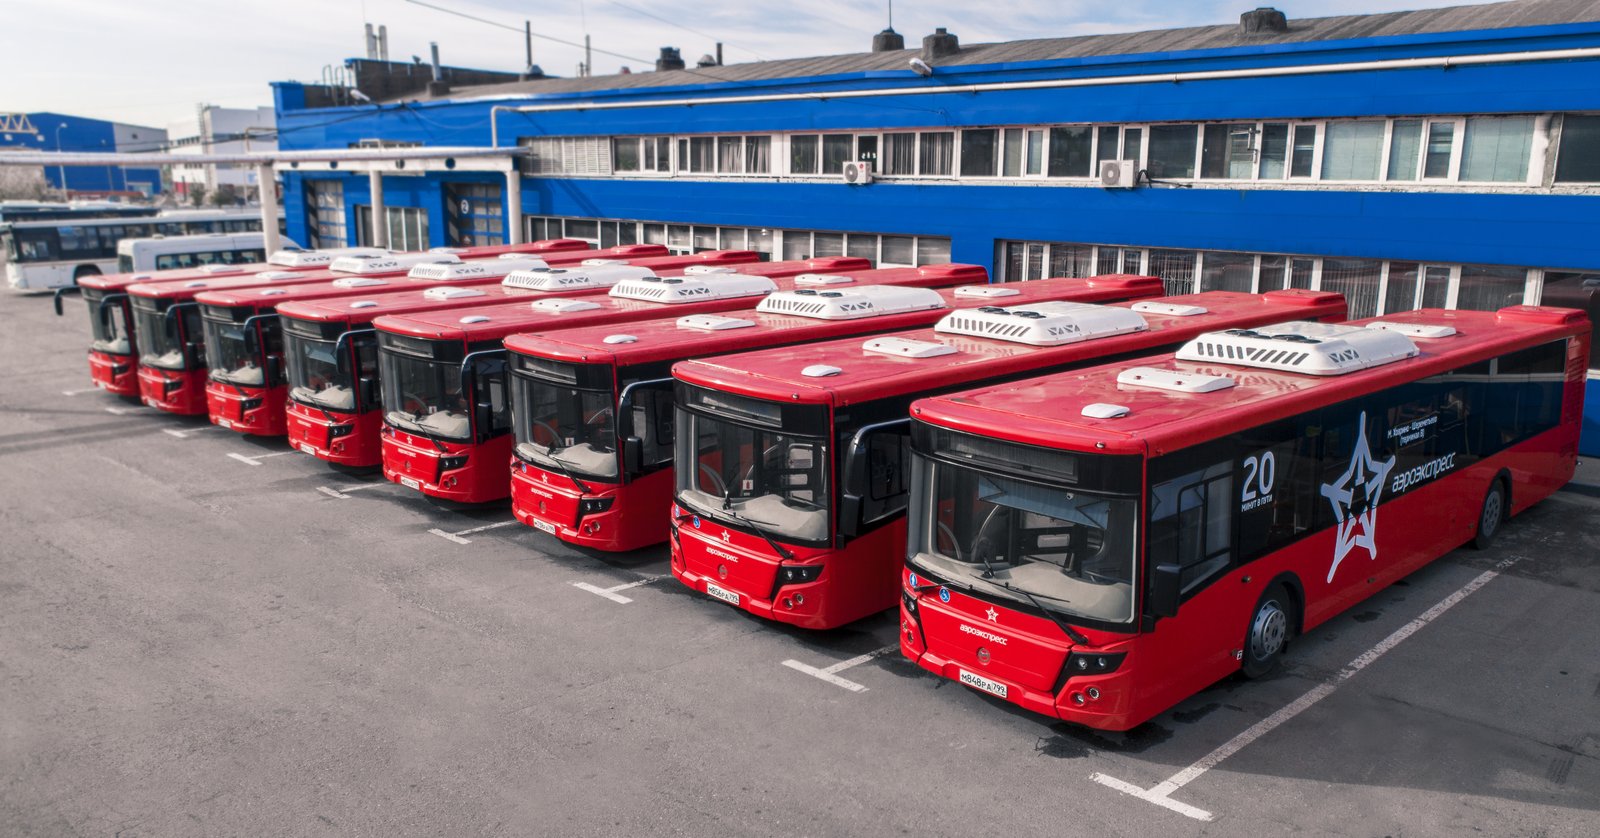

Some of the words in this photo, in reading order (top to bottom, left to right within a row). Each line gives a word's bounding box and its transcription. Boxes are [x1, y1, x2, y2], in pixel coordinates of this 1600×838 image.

[1242, 451, 1275, 502] 20
[1392, 452, 1456, 493] аэроэкспресс
[959, 624, 1008, 645] аэроэкспресс
